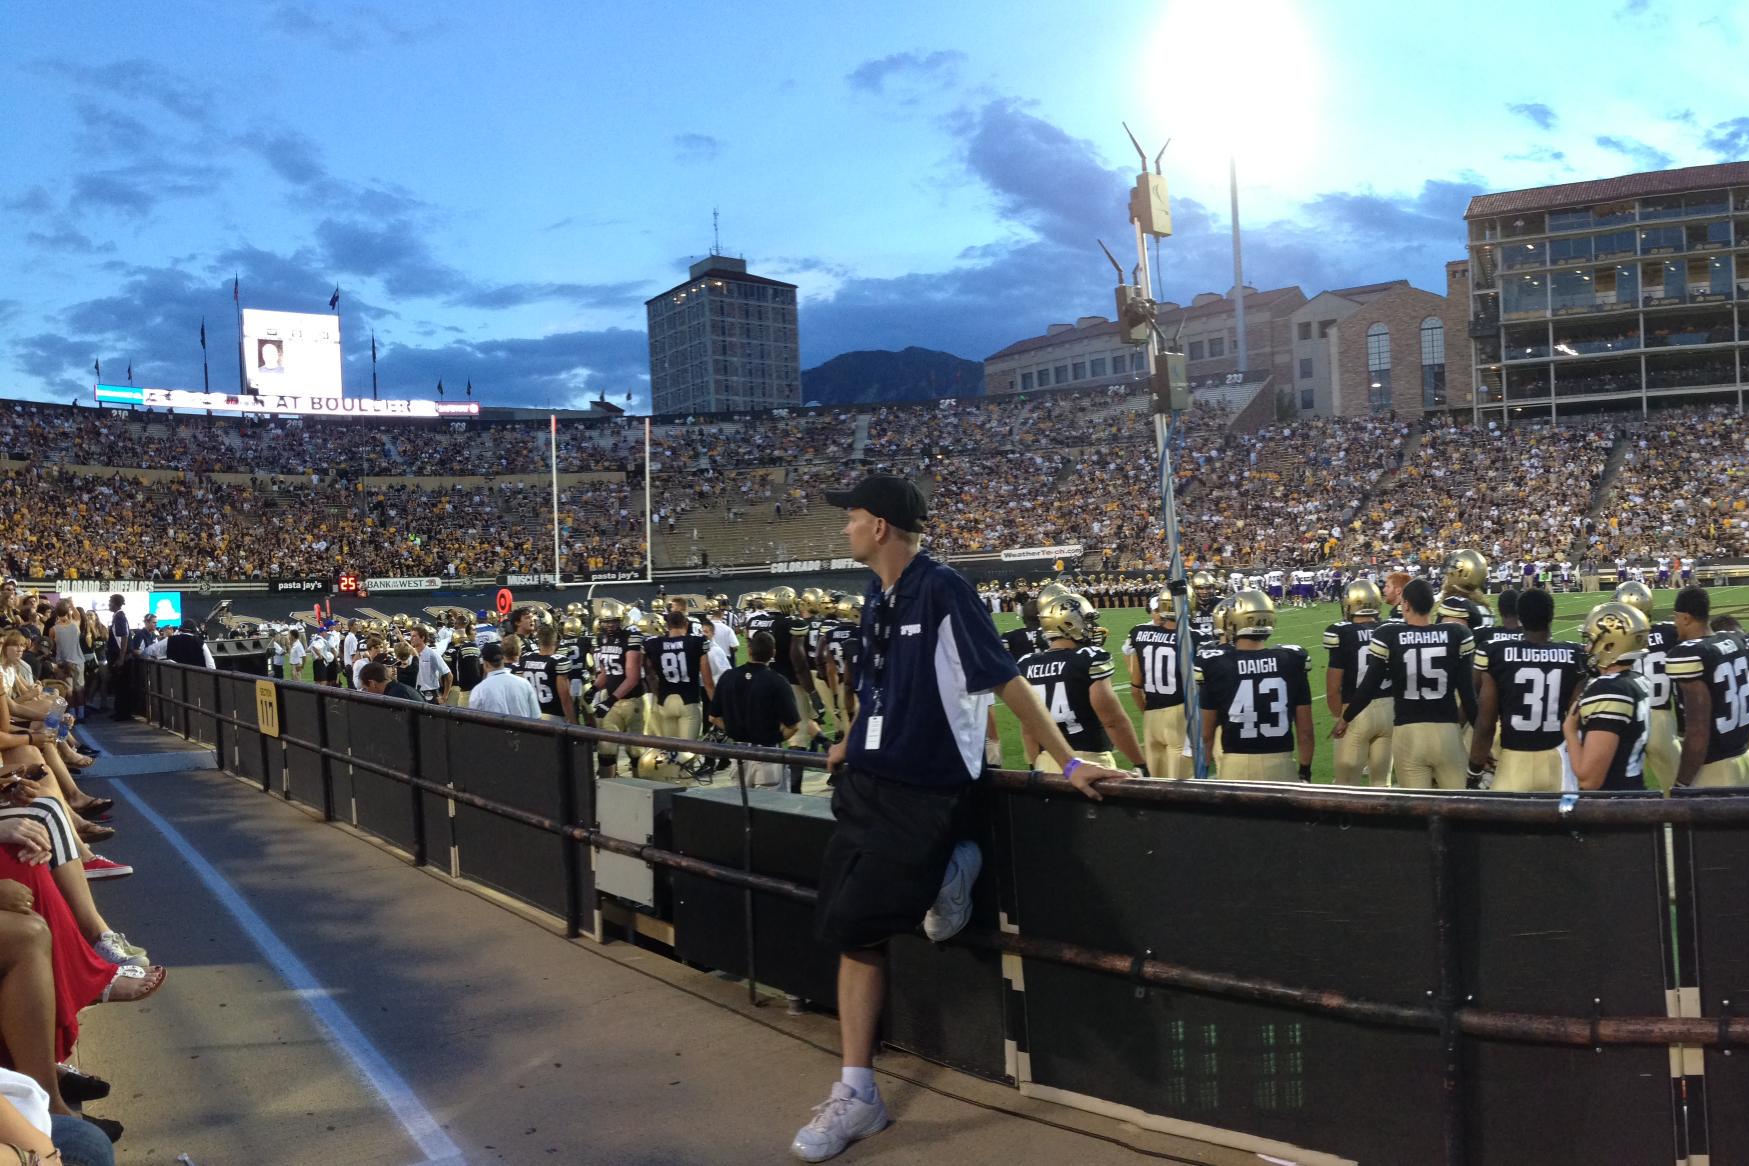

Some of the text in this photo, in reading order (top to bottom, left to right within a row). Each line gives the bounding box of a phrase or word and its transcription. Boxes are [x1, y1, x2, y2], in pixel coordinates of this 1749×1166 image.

[310, 396, 412, 413] BOULER
[278, 580, 322, 590] pasta jay's
[340, 577, 356, 591] 25
[367, 578, 392, 589] BANK
[400, 579, 424, 588] WEST
[507, 575, 539, 585] MUSCLE
[592, 571, 640, 582] pasta jay's
[55, 580, 155, 593] COLORADO BUFFALOES
[1136, 630, 1176, 645] ARCHULE
[1399, 630, 1449, 645] GRAHAM
[1504, 647, 1576, 665] OLUGBODE
[660, 651, 691, 684] 81
[1026, 661, 1067, 679] KELLEY
[1142, 645, 1177, 695] 10
[1237, 657, 1278, 675] DAIGH
[1403, 646, 1448, 700] 15
[1228, 676, 1290, 739] 43
[1510, 667, 1562, 733] 31
[260, 699, 274, 728] 117
